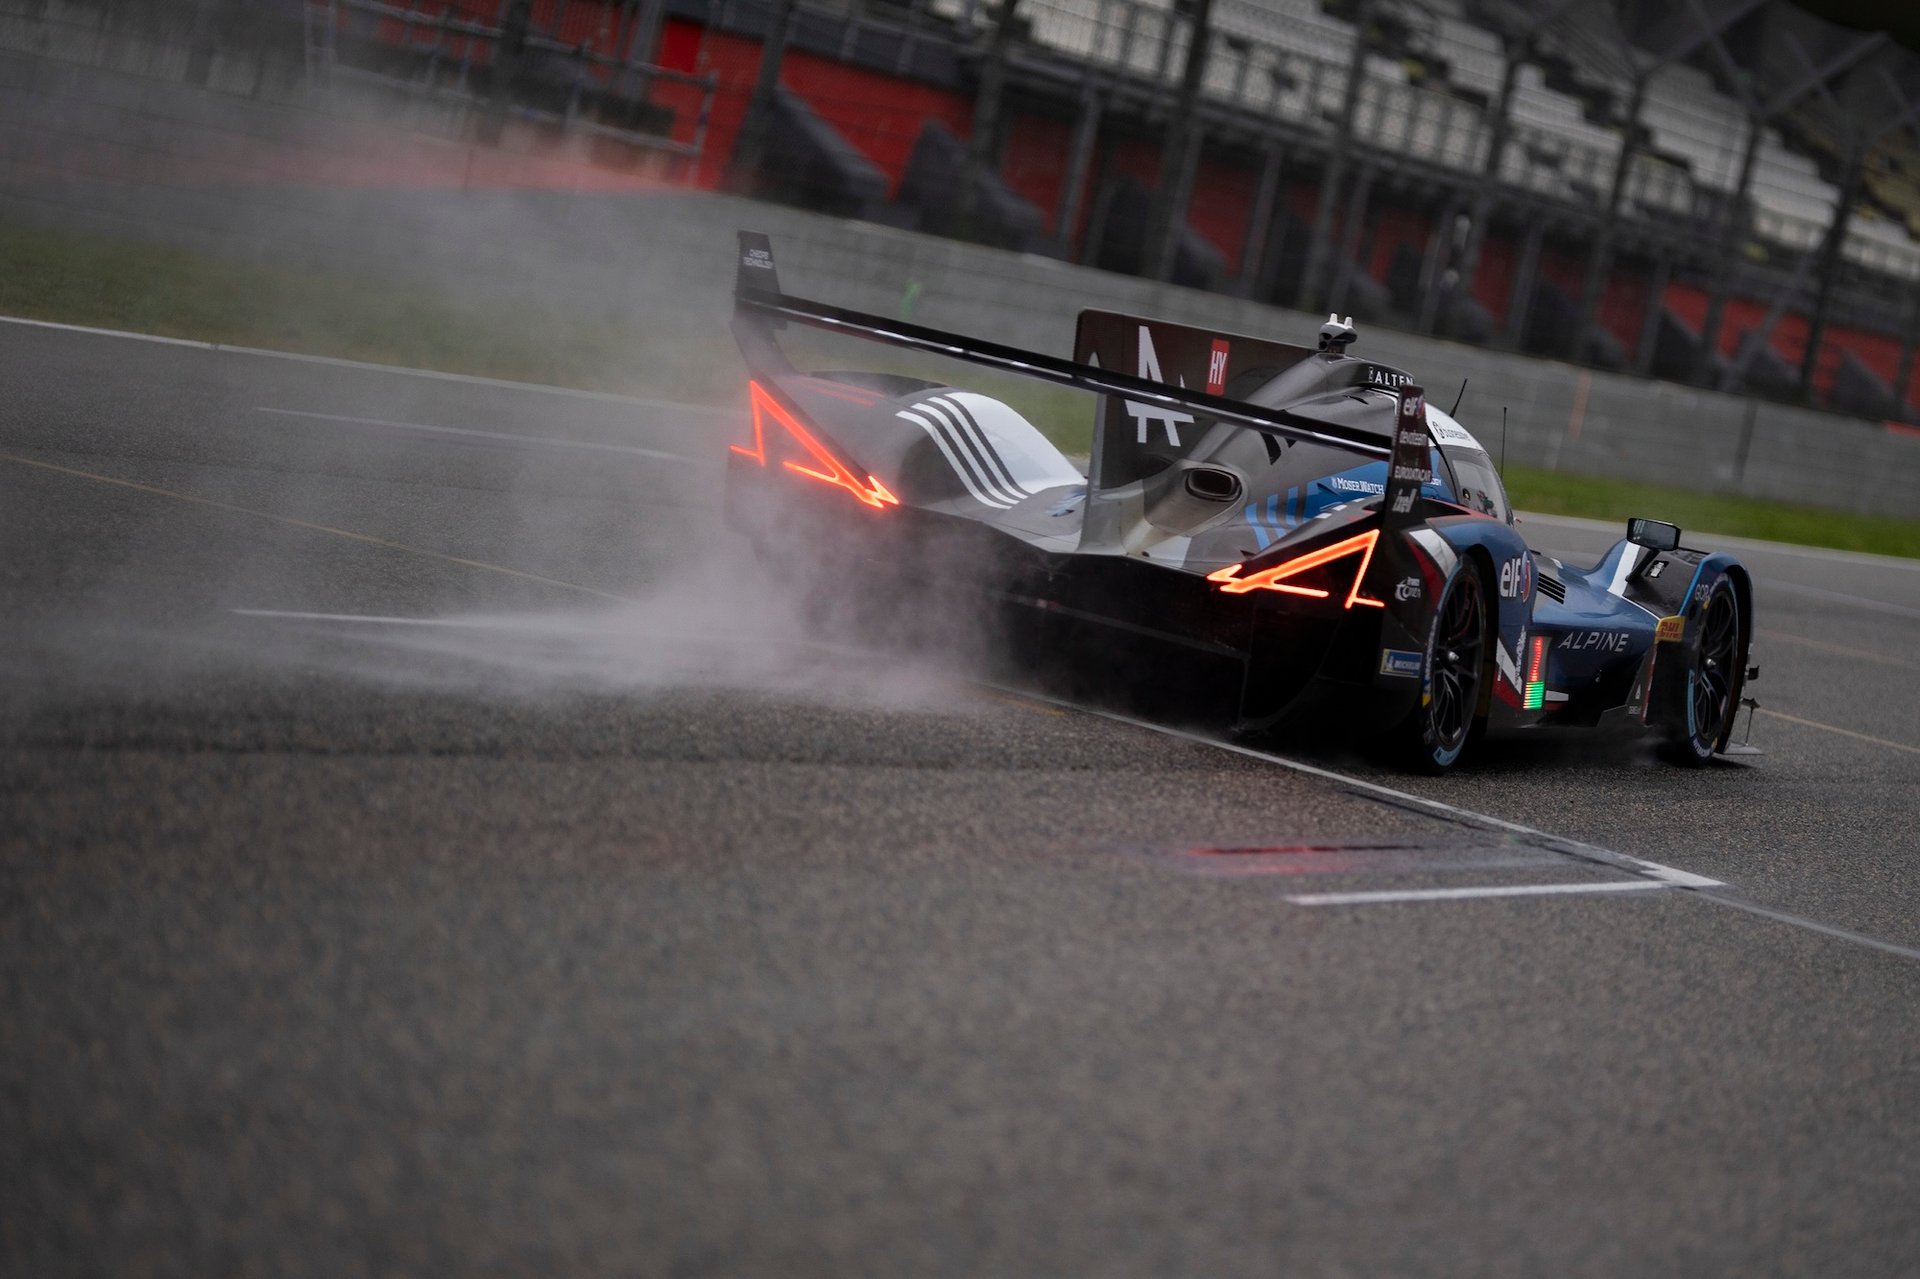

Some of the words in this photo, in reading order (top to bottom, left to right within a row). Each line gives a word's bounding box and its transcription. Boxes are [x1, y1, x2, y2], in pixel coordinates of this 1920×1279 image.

[1208, 350, 1228, 385] HY
[1374, 371, 1414, 387] ALTEN
[1501, 557, 1521, 597] elf
[1558, 631, 1630, 652] ALPINE
